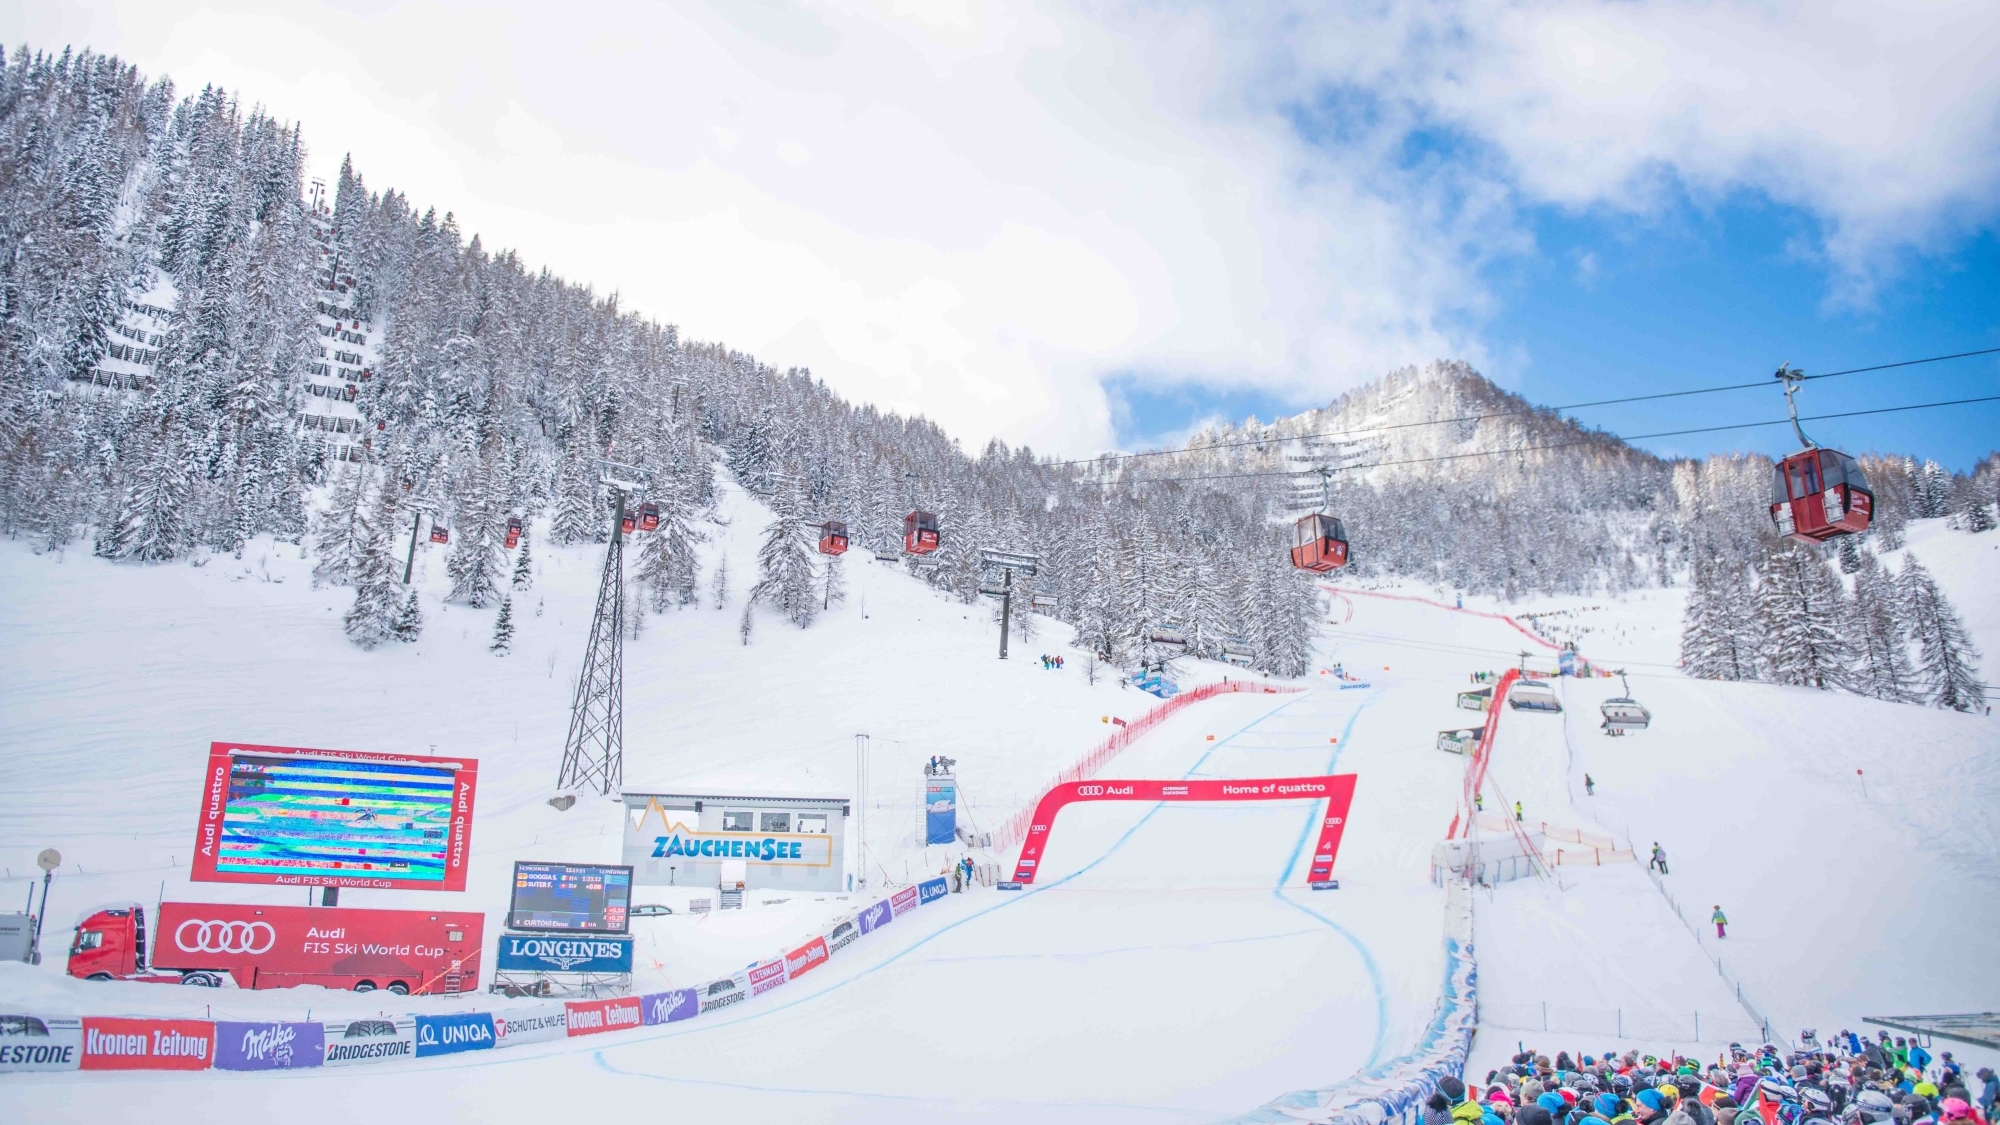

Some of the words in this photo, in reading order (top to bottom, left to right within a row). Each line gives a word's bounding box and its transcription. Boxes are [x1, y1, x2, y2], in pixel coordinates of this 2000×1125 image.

[458, 782, 470, 812] Audi
[1106, 786, 1134, 795] Audi
[1223, 785, 1259, 794] Home
[1262, 784, 1275, 793] of
[1278, 784, 1325, 794] quattro
[202, 823, 216, 856] Audi
[209, 767, 224, 820] quattro
[452, 816, 464, 868] quattro
[275, 875, 301, 884] Audi
[303, 876, 320, 885] FIS
[322, 877, 338, 886] Ski
[340, 878, 371, 887] World
[373, 879, 392, 889] Cup
[306, 928, 345, 939] Audi
[304, 943, 330, 953] FIS
[334, 944, 358, 955] Ski
[361, 944, 410, 956] World
[414, 945, 444, 958] Cup
[510, 939, 622, 959] LONGINES
[567, 1008, 603, 1030] Kronen
[604, 1004, 640, 1026] Zeitung
[652, 991, 686, 1024] Milka
[442, 1023, 492, 1045] UNIQA
[507, 1018, 538, 1034] SCHUTZ
[539, 1017, 545, 1029] &
[86, 1028, 147, 1056] Kronen
[152, 1029, 208, 1060] Zeitung
[241, 1024, 297, 1061] Milka
[326, 1041, 411, 1061] BRIDGESTONE
